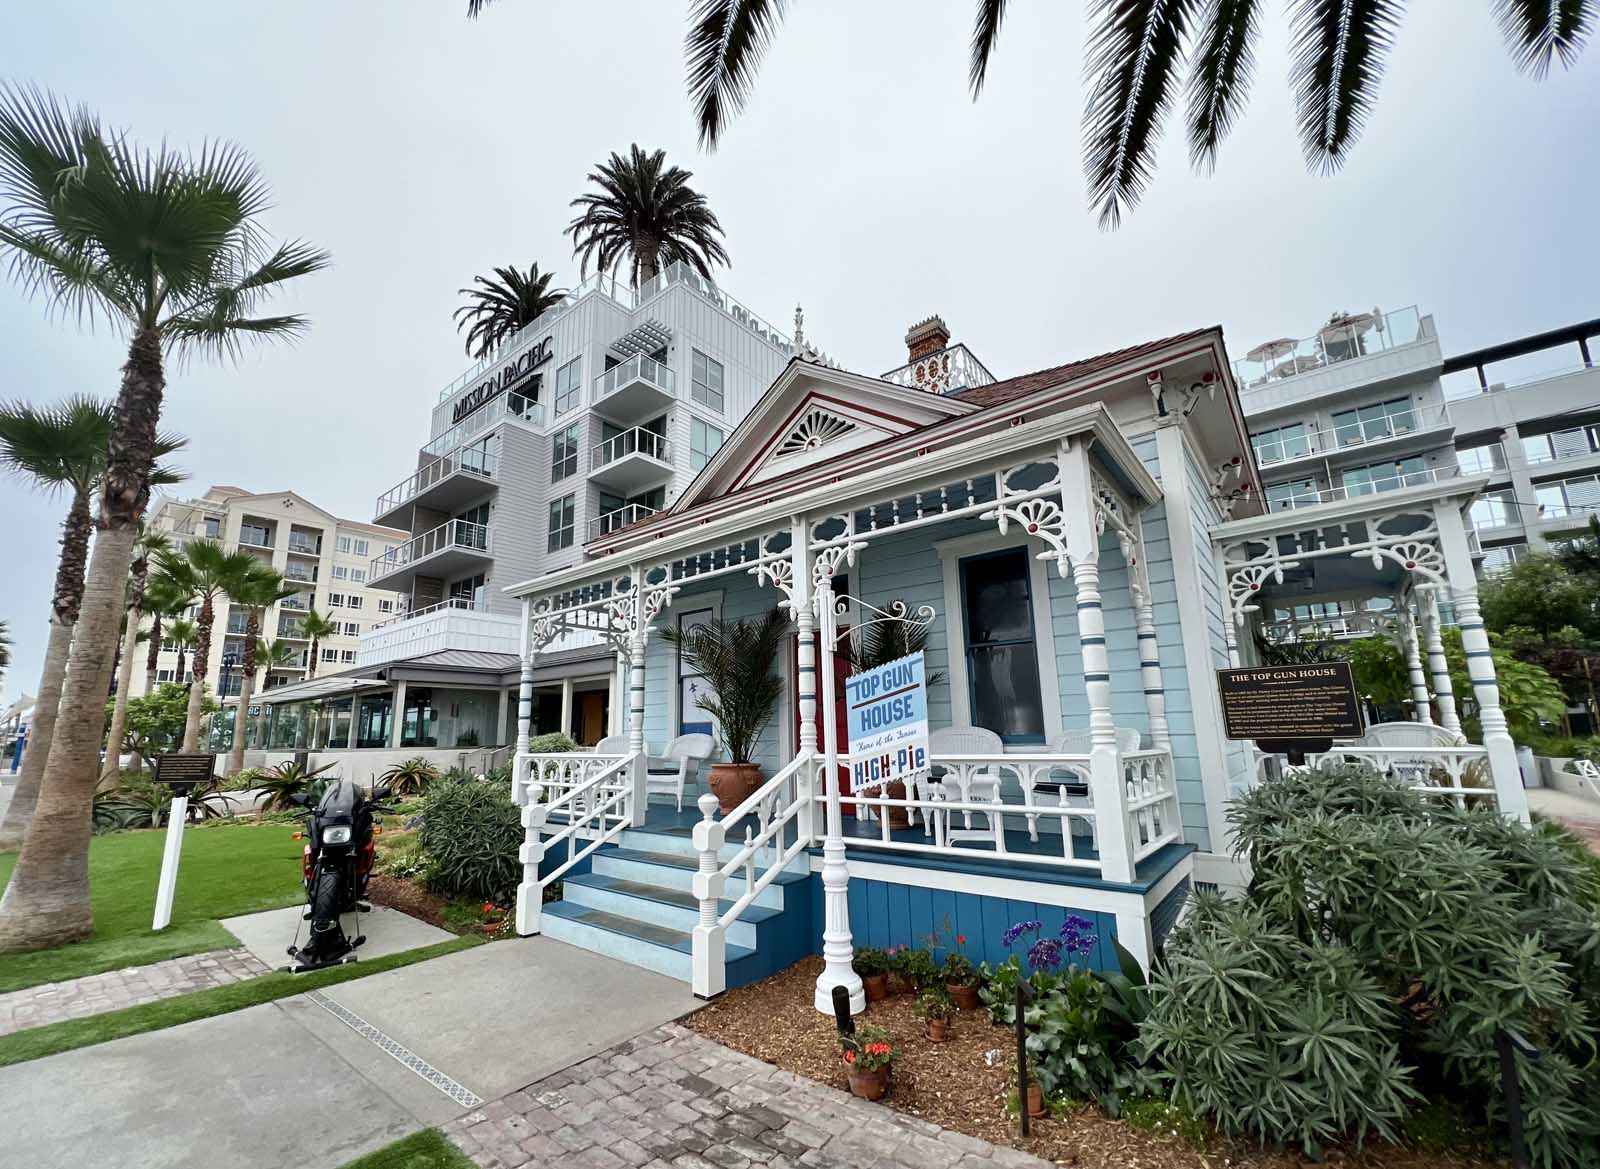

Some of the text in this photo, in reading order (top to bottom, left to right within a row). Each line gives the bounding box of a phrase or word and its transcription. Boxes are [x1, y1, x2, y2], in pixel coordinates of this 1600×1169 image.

[453, 336, 553, 421] MISSION PACIFIC
[847, 659, 923, 701] TOP GUN
[1231, 668, 1337, 682] THE TOP GUN HOUSE
[861, 694, 914, 732] HOUSE
[856, 740, 874, 752] Home
[875, 736, 882, 747] of
[884, 733, 894, 744] the
